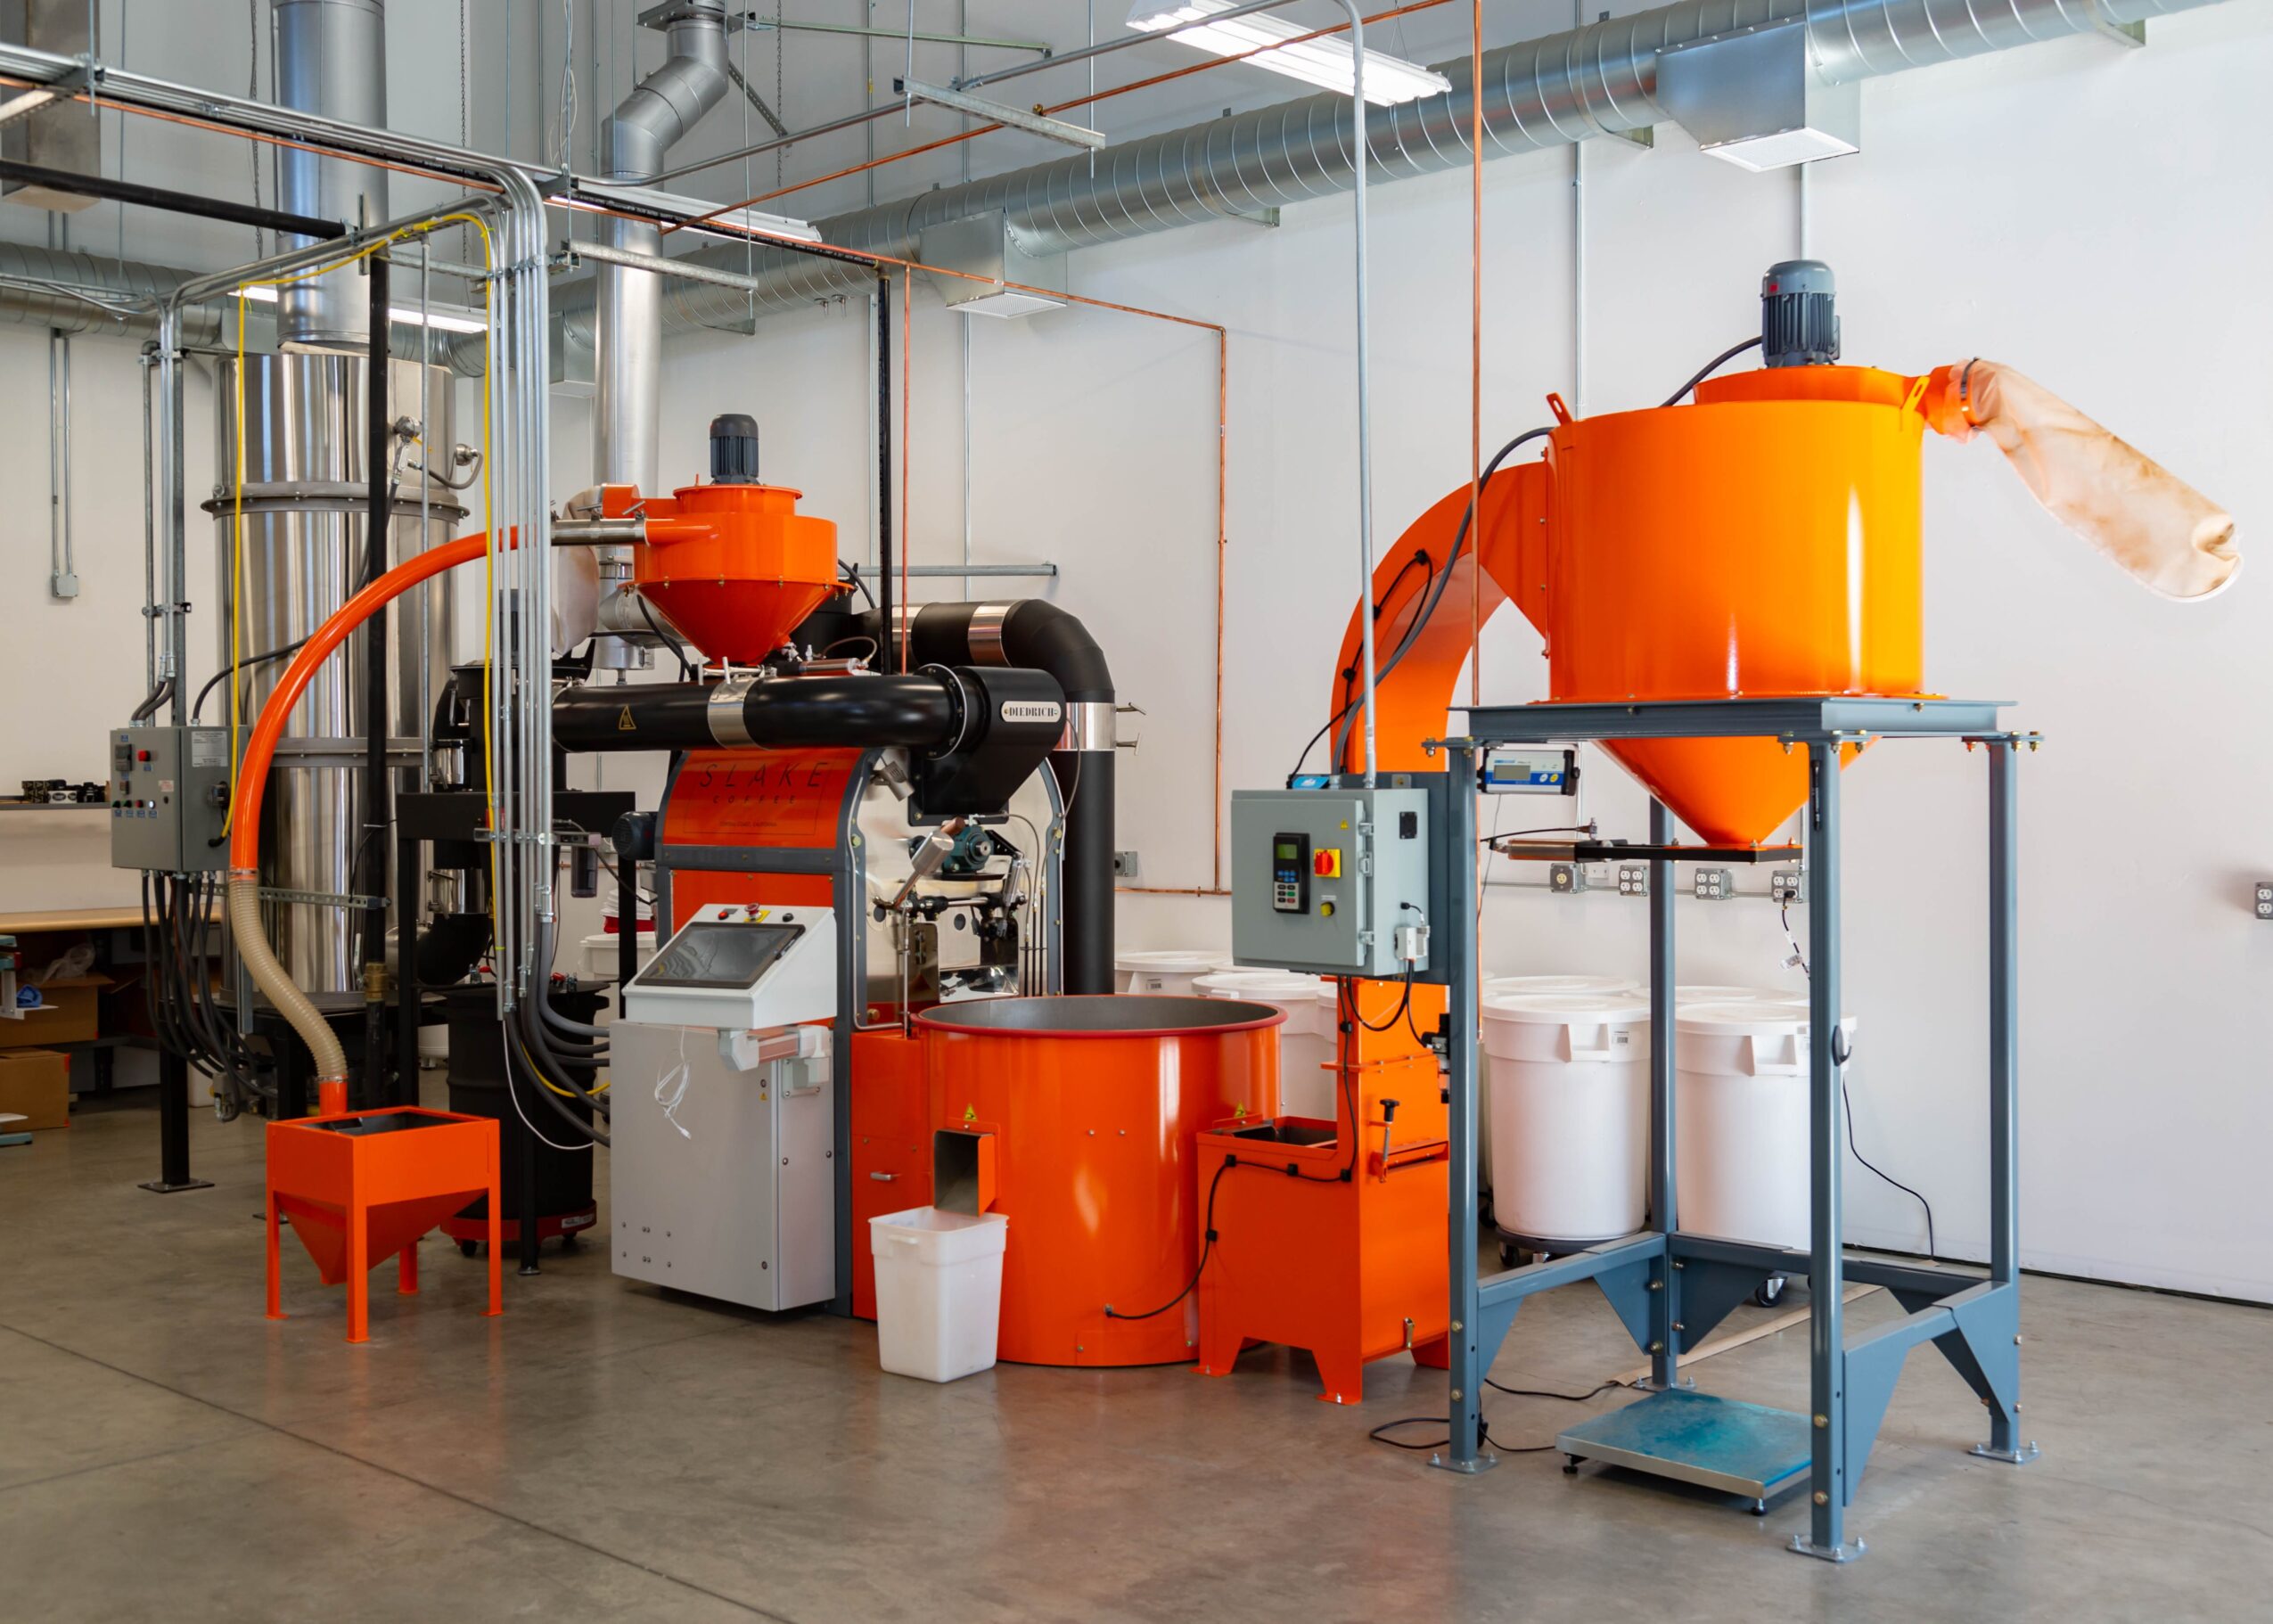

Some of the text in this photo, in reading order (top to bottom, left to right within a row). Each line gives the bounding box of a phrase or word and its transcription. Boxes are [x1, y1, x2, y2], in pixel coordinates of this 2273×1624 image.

[1009, 707, 1054, 717] DIEDRICH
[700, 762, 828, 788] SLAKE
[713, 795, 796, 804] COFFEE
